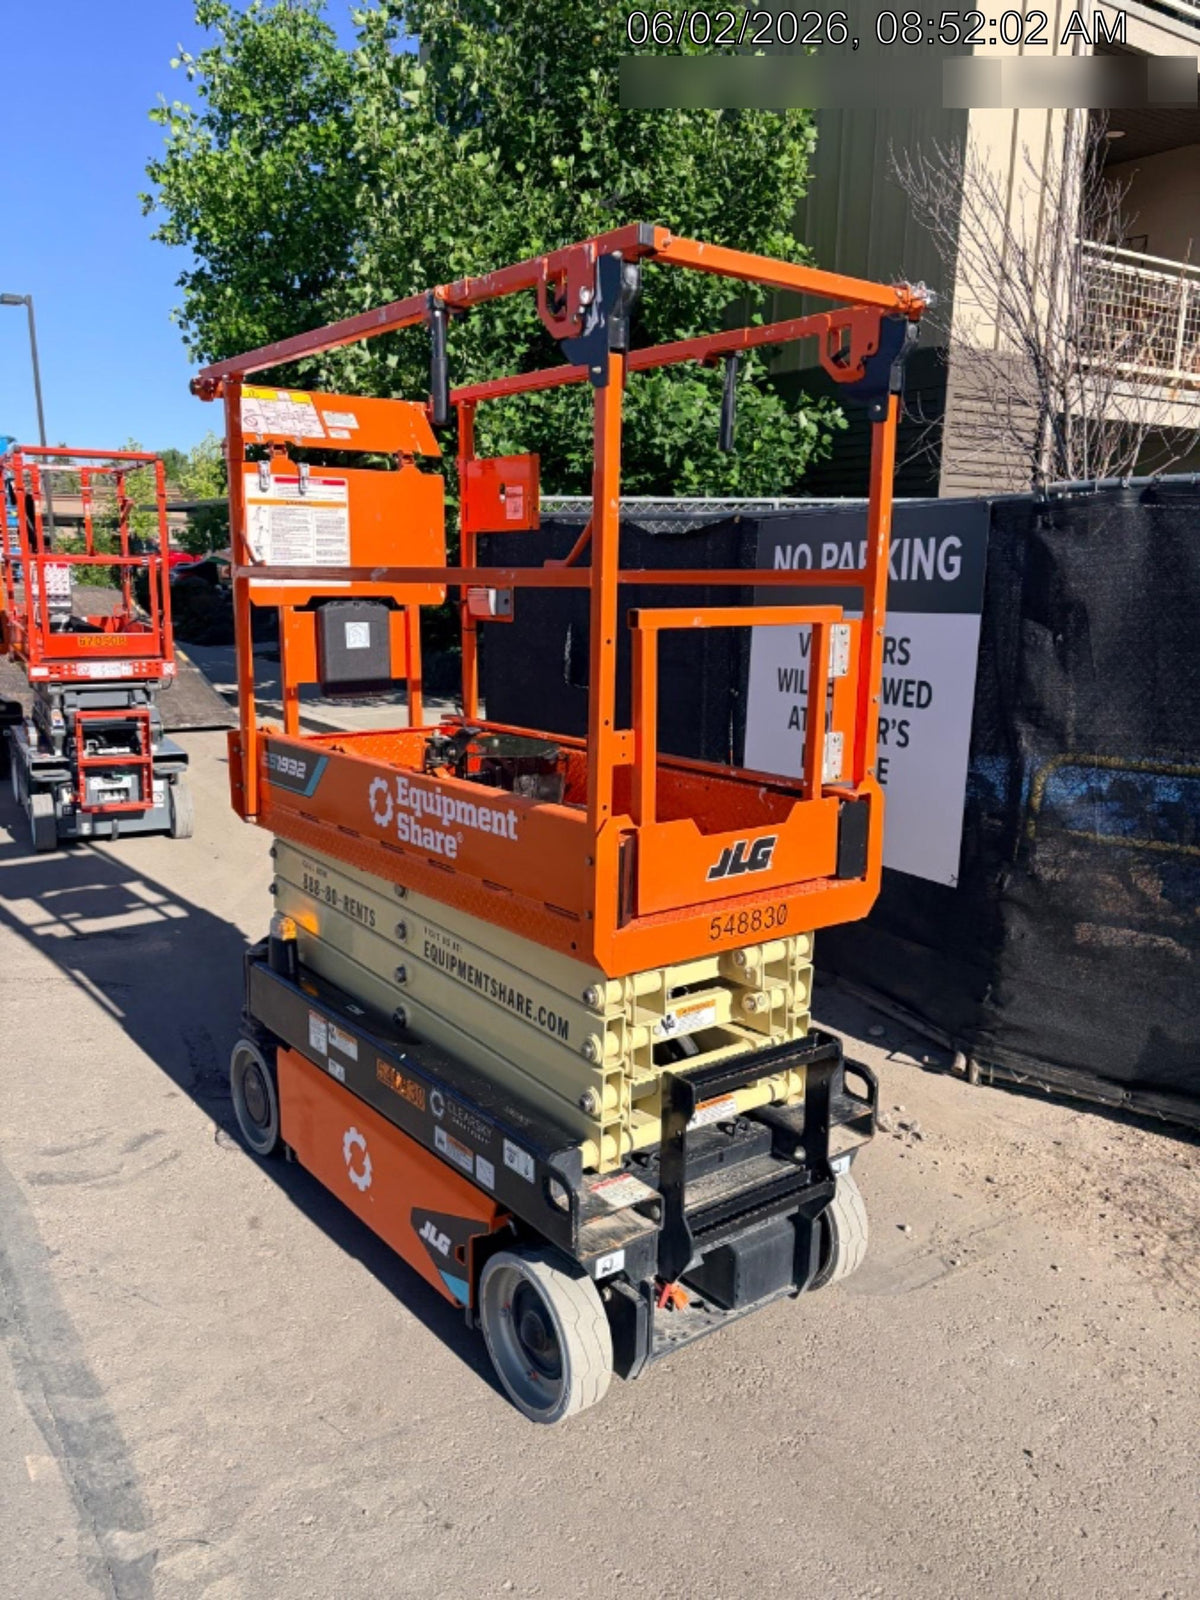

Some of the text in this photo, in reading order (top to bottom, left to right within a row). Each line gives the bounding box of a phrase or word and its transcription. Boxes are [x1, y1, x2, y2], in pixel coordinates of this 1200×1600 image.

[396, 776, 518, 841] Equipment
[706, 835, 778, 881] JLG
[710, 903, 787, 940] 548830
[424, 940, 570, 1041] EQUIPMENTSHARE.COM
[419, 1220, 452, 1257] JLG
